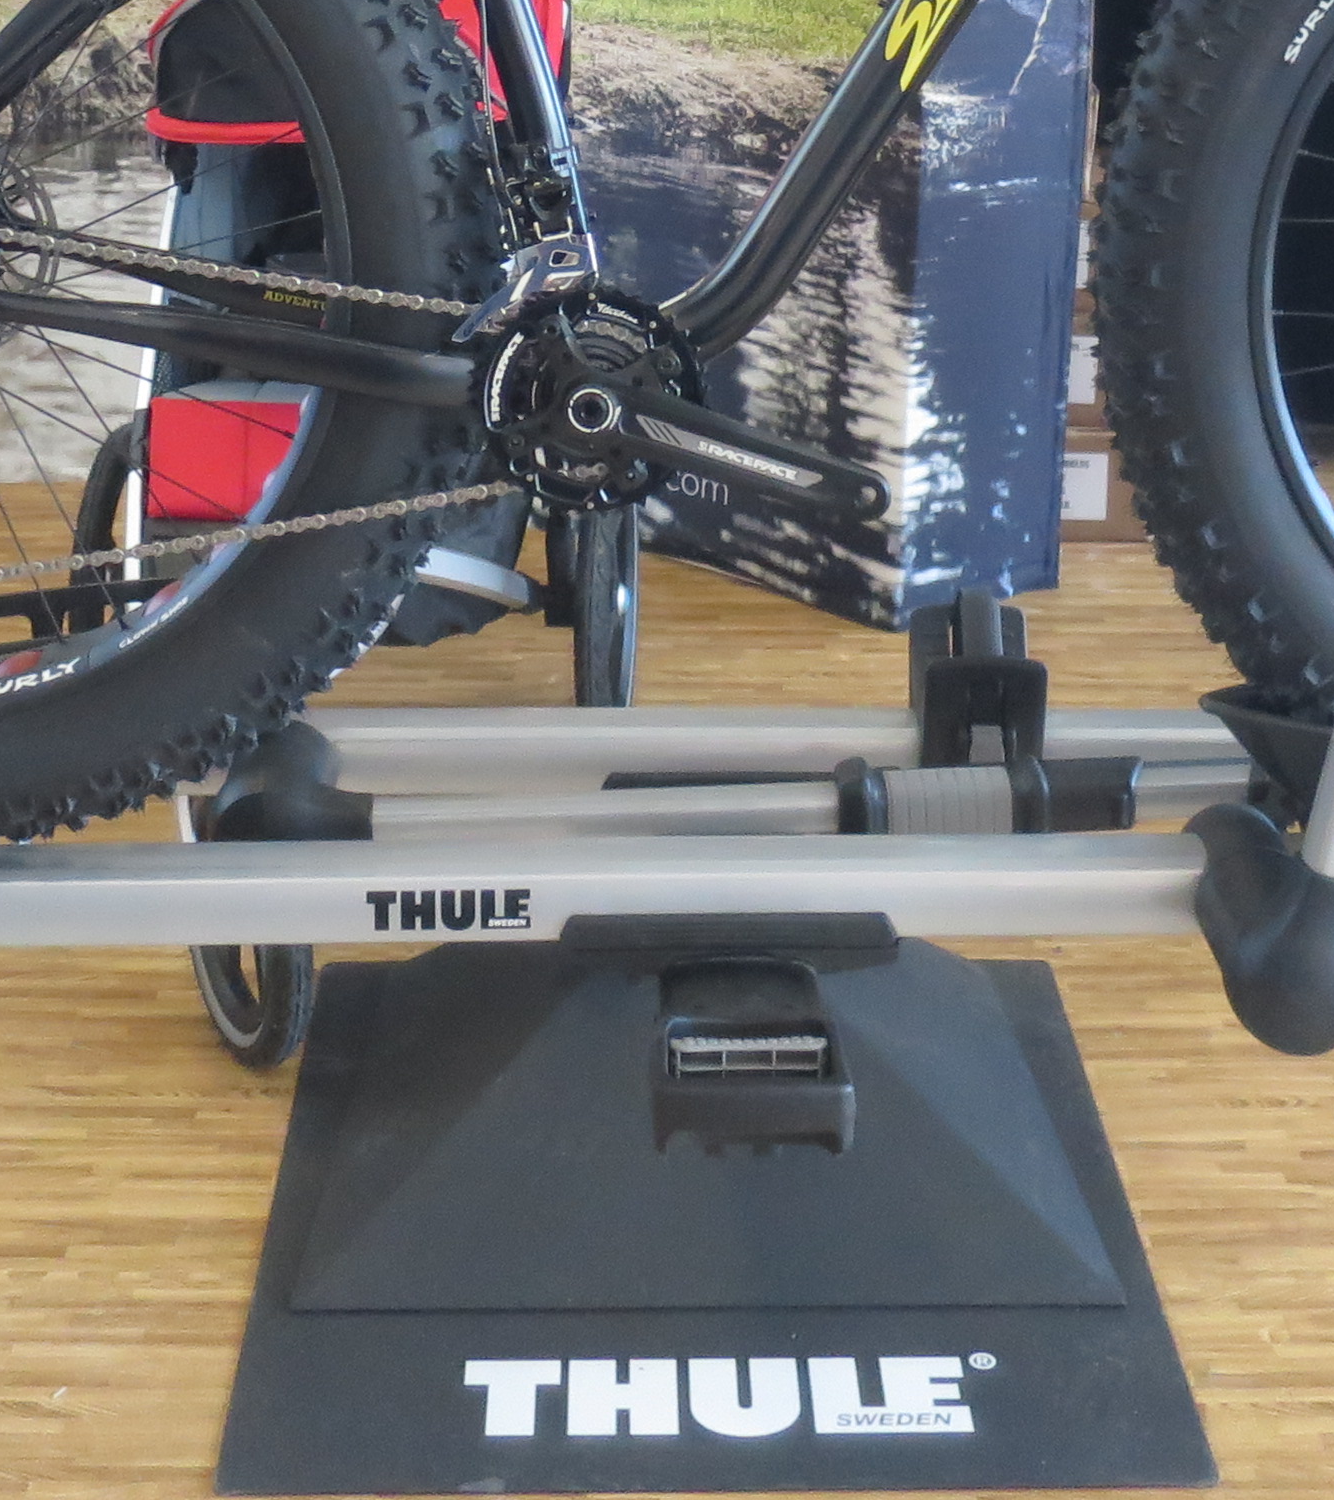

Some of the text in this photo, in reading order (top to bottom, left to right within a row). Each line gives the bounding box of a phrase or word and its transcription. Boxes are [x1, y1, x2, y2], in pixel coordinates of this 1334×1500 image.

[366, 889, 531, 931] THULE
[487, 917, 527, 928] SWEDEN
[464, 1356, 975, 1438] THULE
[836, 1411, 953, 1428] SWEDEN
